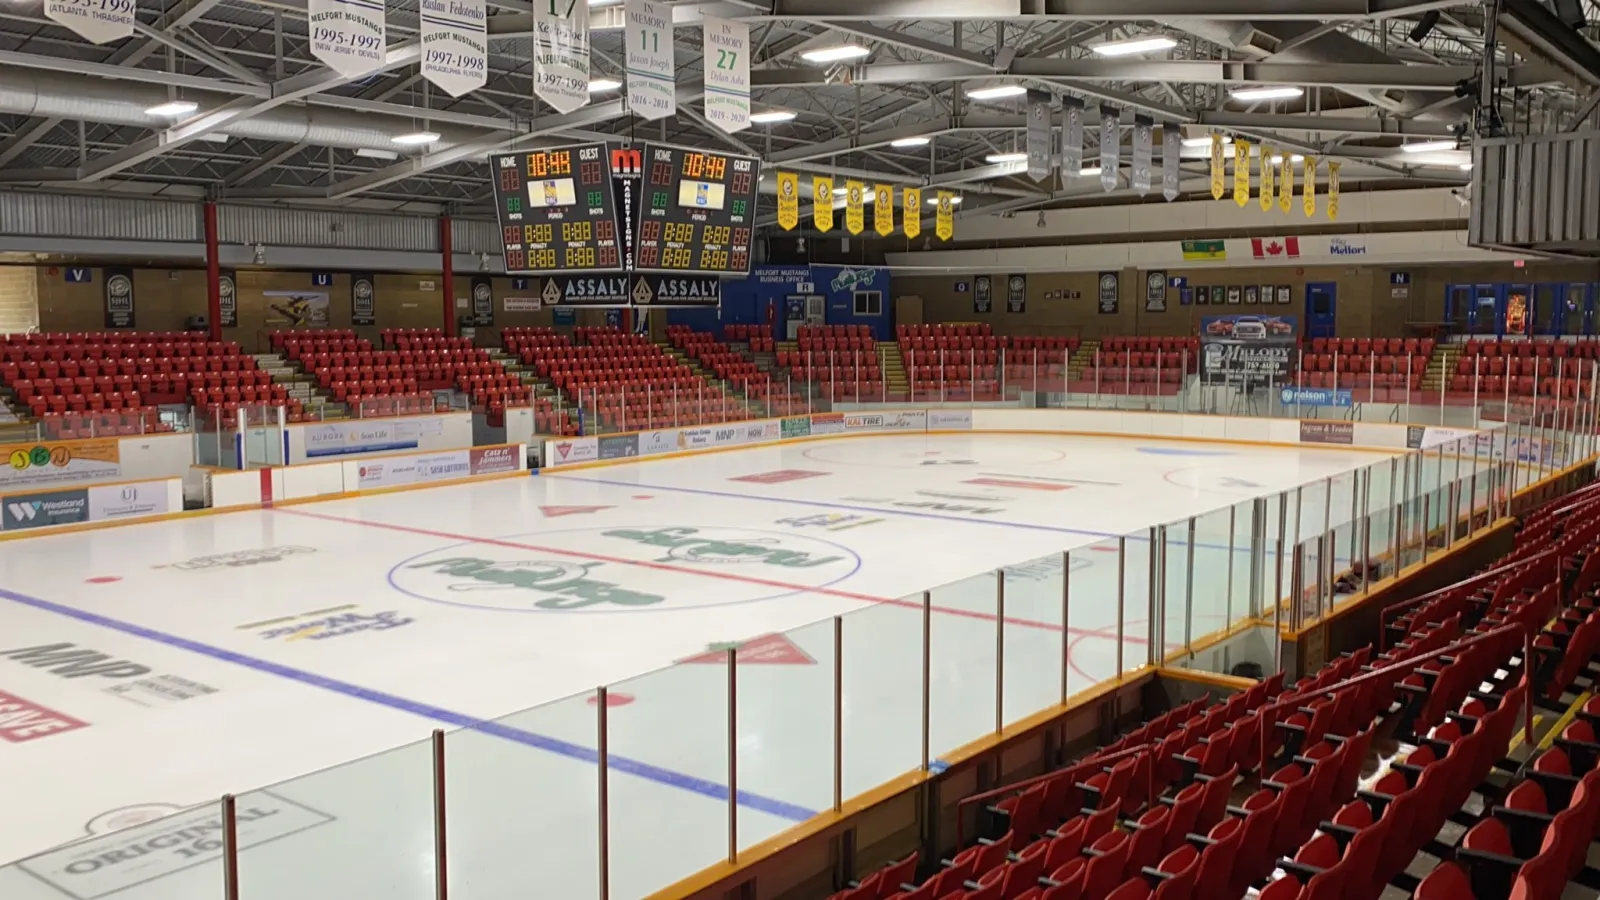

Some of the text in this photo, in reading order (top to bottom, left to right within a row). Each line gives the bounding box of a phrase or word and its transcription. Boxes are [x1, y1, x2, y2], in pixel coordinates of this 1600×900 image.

[50, 4, 88, 17] (ATLANTA
[422, 0, 484, 20] Ruslan Fedotenko
[644, 2, 654, 13] IN
[311, 12, 382, 34] MELFORT MUSTANGS
[630, 12, 666, 30] MEMORY
[722, 24, 732, 34] IN
[314, 27, 381, 50] 1995-1997
[424, 32, 485, 54] MELFORT MUSTANGS
[641, 29, 658, 52] 11
[710, 33, 743, 49] MEMORY
[315, 42, 380, 60] (NEW JERSEY DEVILS)
[717, 48, 737, 70] 27
[426, 50, 484, 70] 1997-1998
[650, 56, 670, 72] Joseph
[537, 72, 588, 92] 1997-1999
[632, 93, 647, 106] 2016
[653, 98, 668, 109] 2018
[500, 156, 516, 168] HOME
[580, 148, 599, 160] GUEST
[654, 150, 672, 162] HOME
[528, 150, 570, 176] 10:44
[684, 153, 726, 180] 10:44
[734, 160, 752, 172] GUEST
[623, 180, 632, 271] MAGNETSIGNS.COM
[72, 269, 83, 281] V
[318, 275, 326, 285] U
[1174, 278, 1181, 287] P
[1396, 273, 1404, 283] N
[565, 278, 628, 296] ASSALY
[658, 279, 718, 296] ASSALY
[958, 283, 966, 292] Q
[1220, 344, 1291, 360] MELODY
[1294, 390, 1325, 399] nelson
[847, 418, 861, 426] KAL
[862, 417, 880, 426] TIRE
[361, 430, 388, 439] Sun Life
[716, 429, 735, 440] MNP
[42, 498, 85, 511] Westland
[0, 642, 152, 678] MNP
[172, 837, 224, 860] 16
